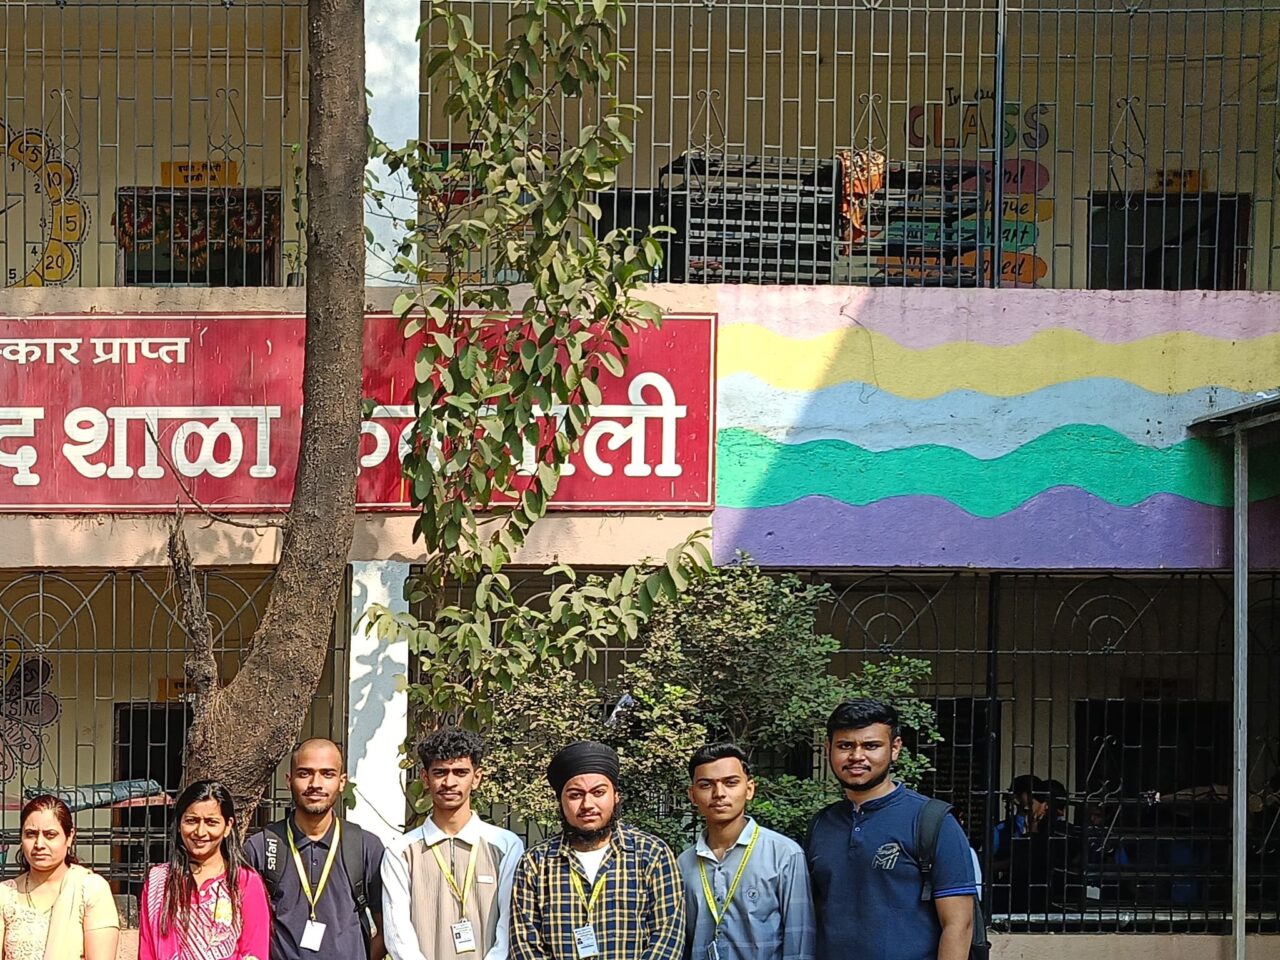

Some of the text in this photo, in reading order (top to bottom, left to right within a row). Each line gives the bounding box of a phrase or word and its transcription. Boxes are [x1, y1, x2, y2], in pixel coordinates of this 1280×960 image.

[904, 103, 1050, 149] CLASS
[91, 336, 190, 365] प्राप्त
[64, 404, 282, 480] शाळा
[266, 838, 278, 871] safari
